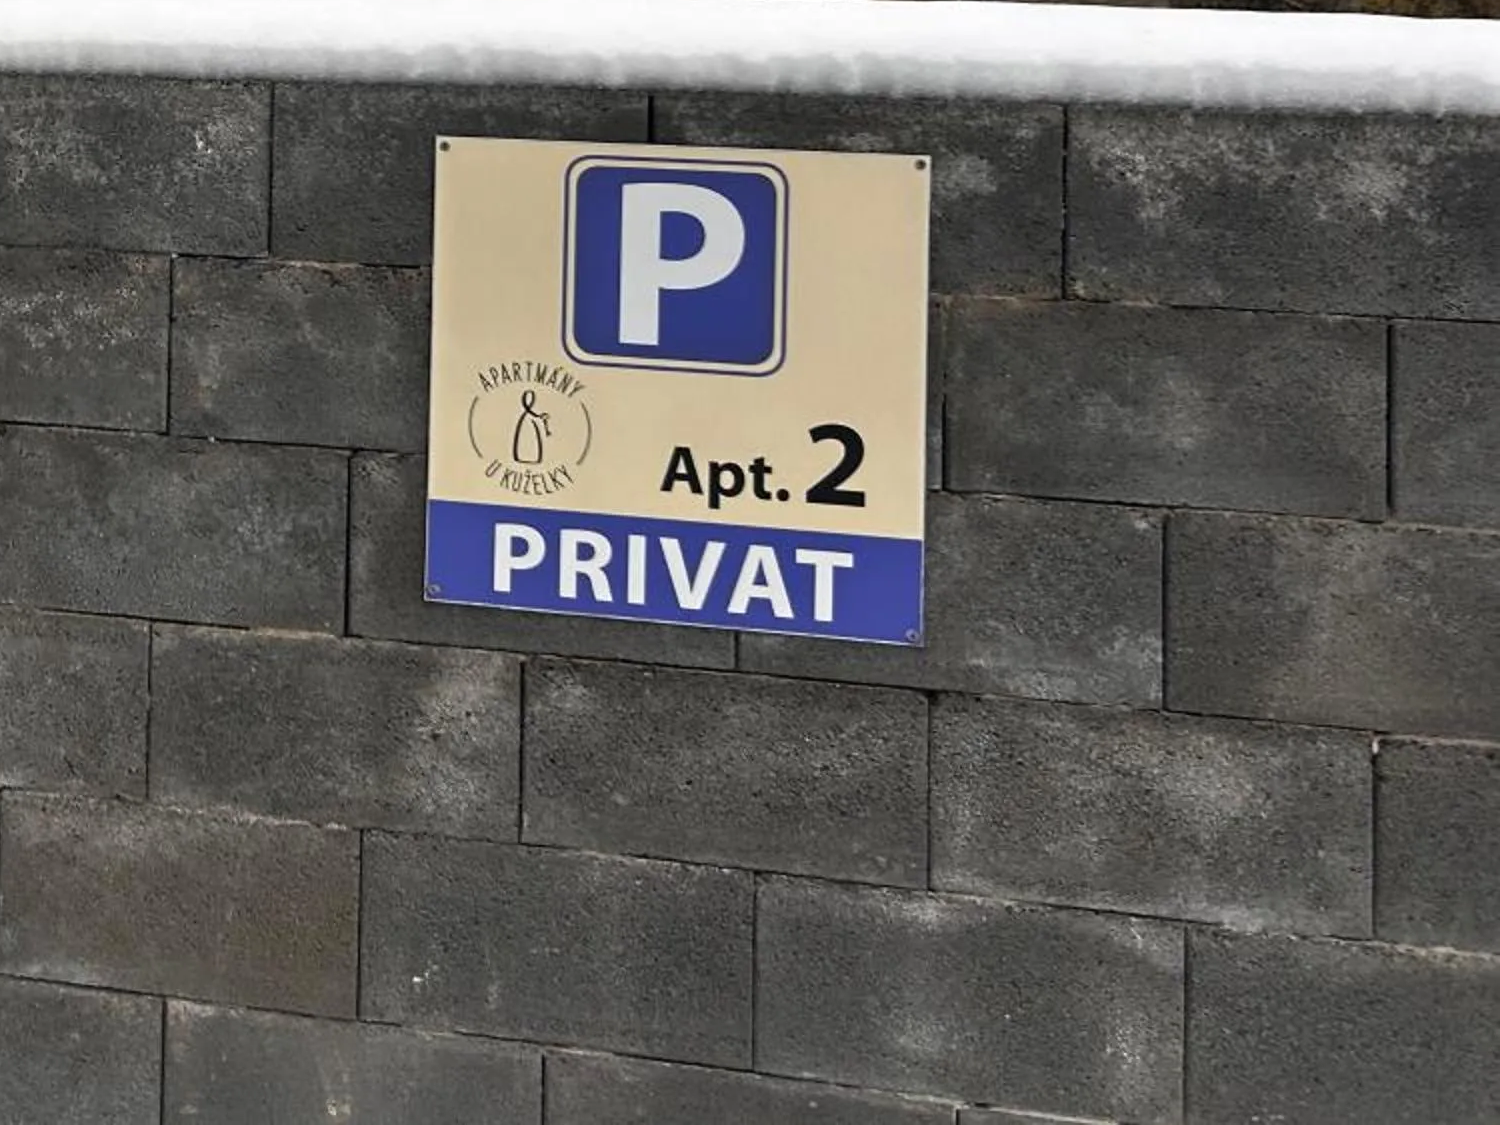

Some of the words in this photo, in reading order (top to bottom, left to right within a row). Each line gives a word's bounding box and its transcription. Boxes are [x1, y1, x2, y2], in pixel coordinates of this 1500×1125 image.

[619, 182, 746, 346] P
[485, 459, 502, 478] U
[660, 446, 791, 509] Apt.
[805, 423, 867, 508] 2
[492, 522, 854, 623] PRIVAT
